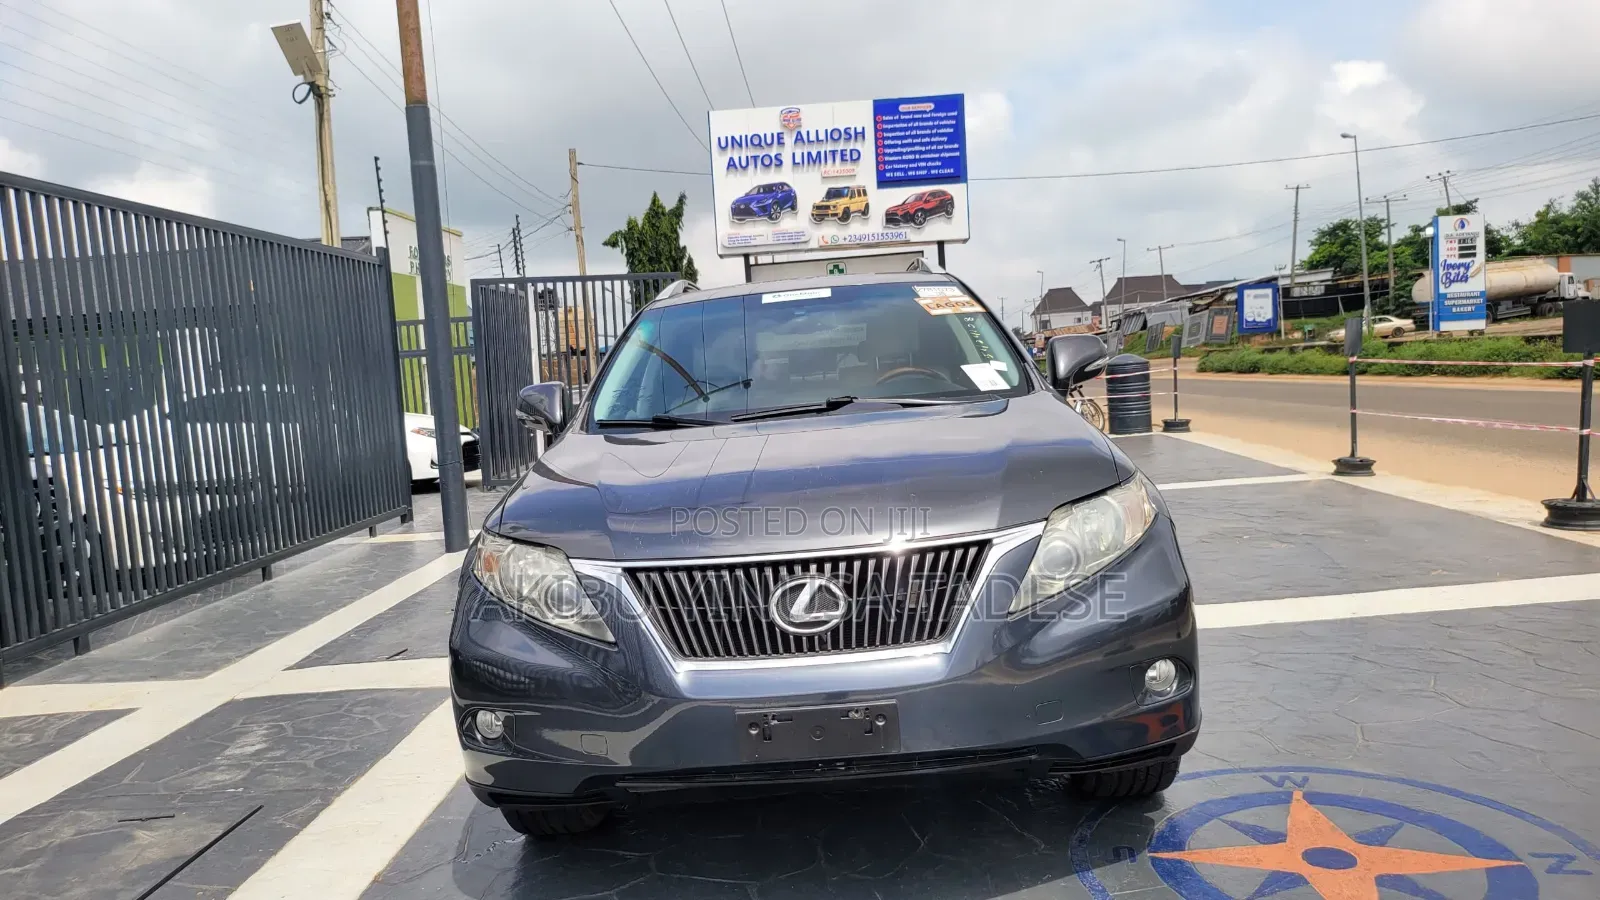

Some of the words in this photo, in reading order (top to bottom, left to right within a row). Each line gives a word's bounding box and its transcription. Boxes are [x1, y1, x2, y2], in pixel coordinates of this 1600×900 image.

[718, 132, 785, 150] UNIQUE
[794, 126, 865, 144] ALLIOSH
[726, 153, 783, 170] AUTOS
[792, 148, 861, 166] LIMITED
[842, 232, 907, 242] +2349151553961
[1440, 259, 1474, 274] Ivory
[1441, 271, 1470, 288] Bites
[925, 301, 975, 310] LAGOS
